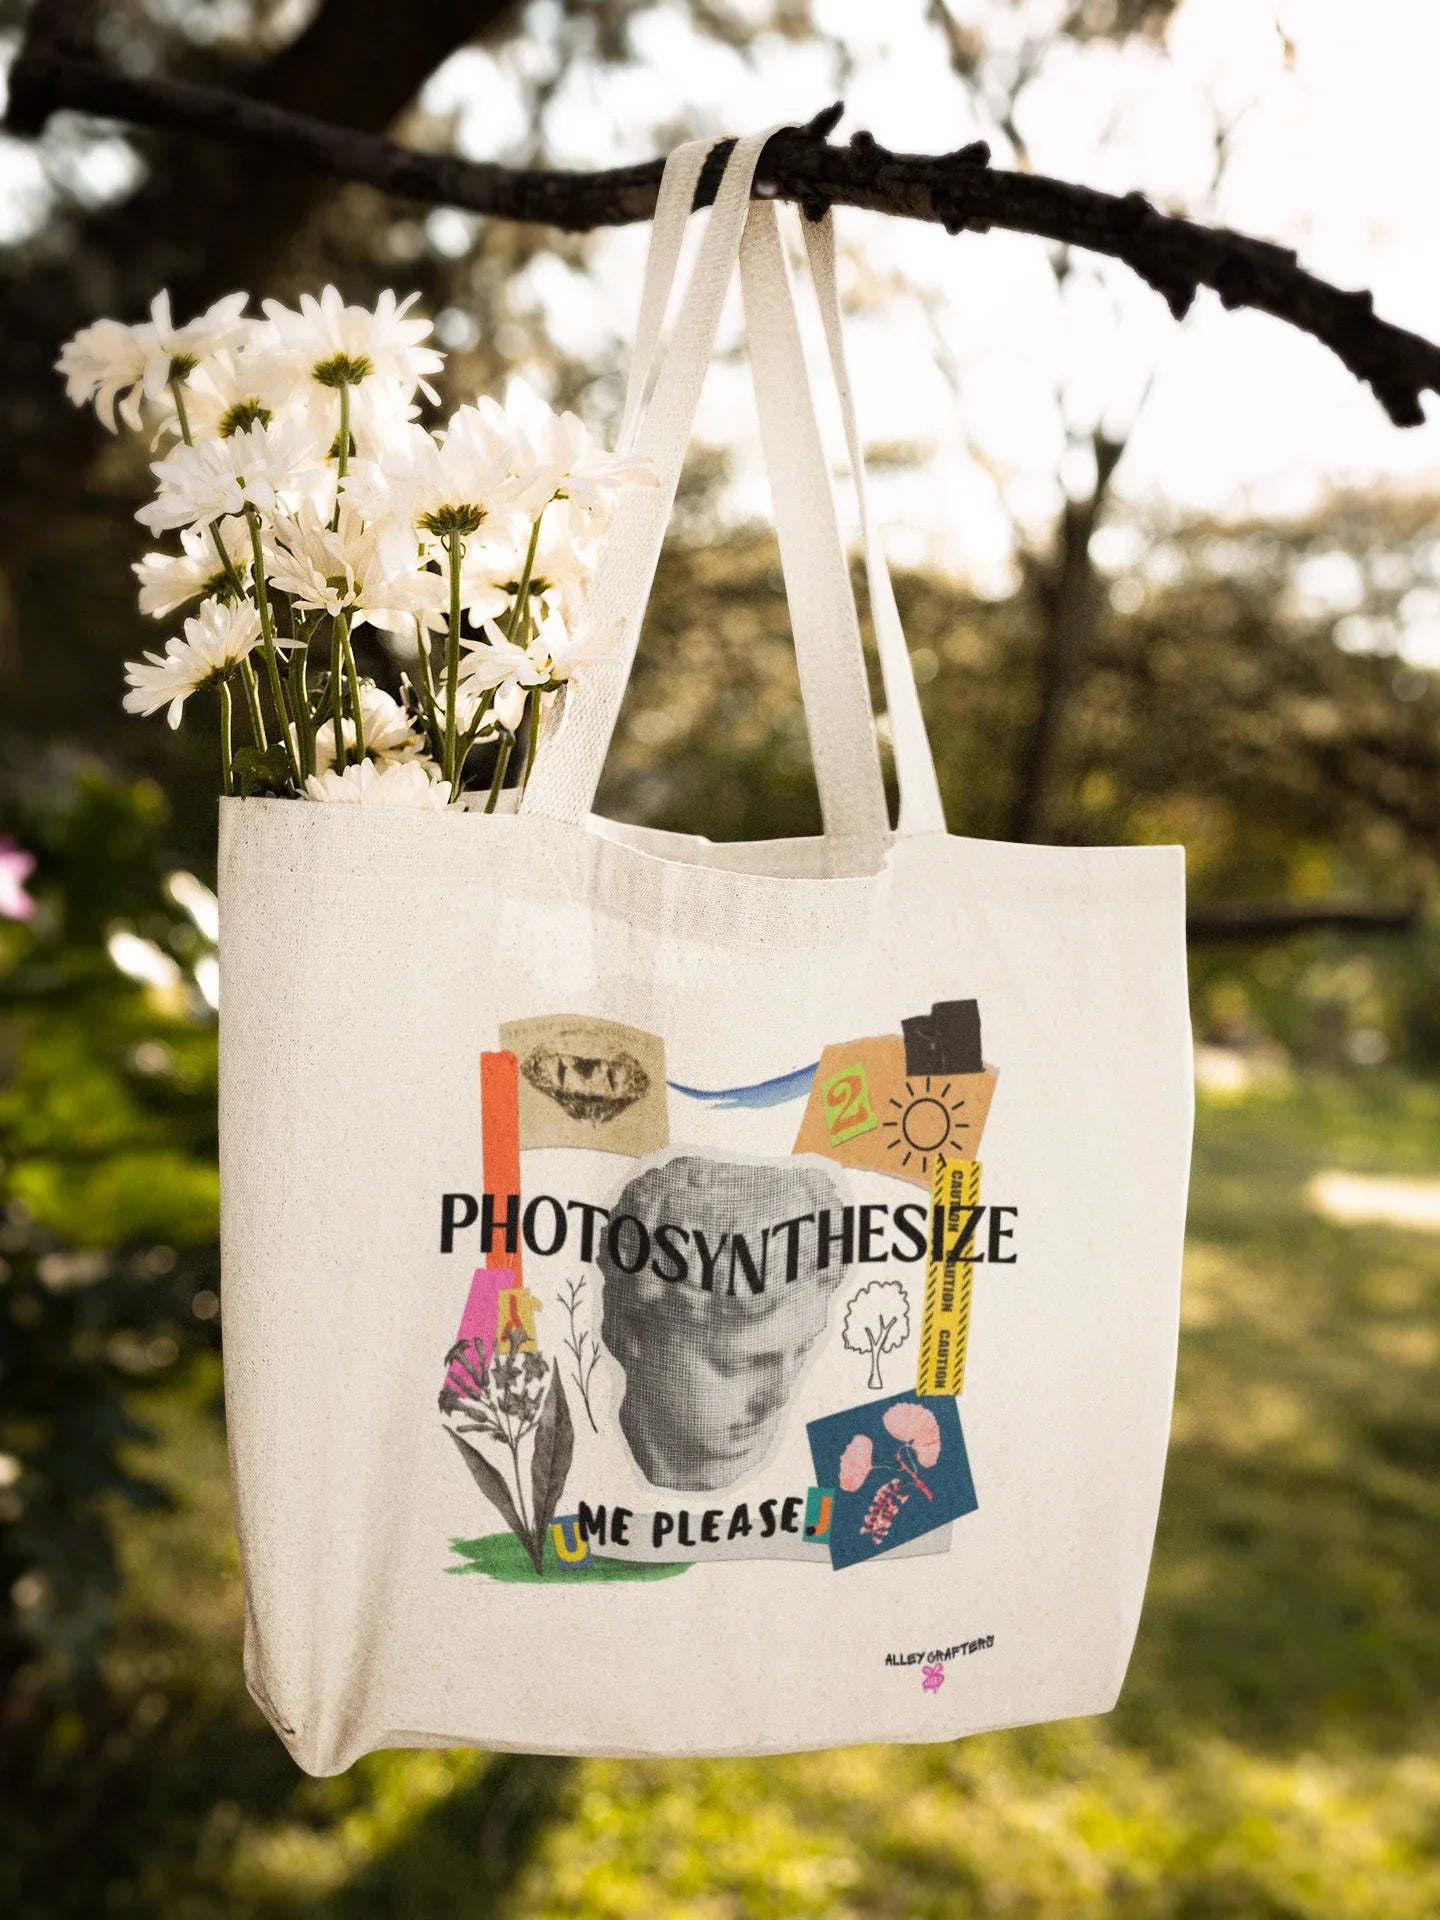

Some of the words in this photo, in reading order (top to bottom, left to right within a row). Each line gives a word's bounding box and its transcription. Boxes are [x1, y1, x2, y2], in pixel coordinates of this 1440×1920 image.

[827, 1075, 868, 1135] 2
[948, 1170, 964, 1233] CAUTON
[439, 1193, 1018, 1296] PHOTOSYNTHESIZE
[941, 1250, 957, 1312] AUTION
[935, 1329, 950, 1389] CAUTION
[553, 1522, 588, 1562] U
[578, 1501, 633, 1546] ME
[885, 1652, 925, 1666] ALLEY
